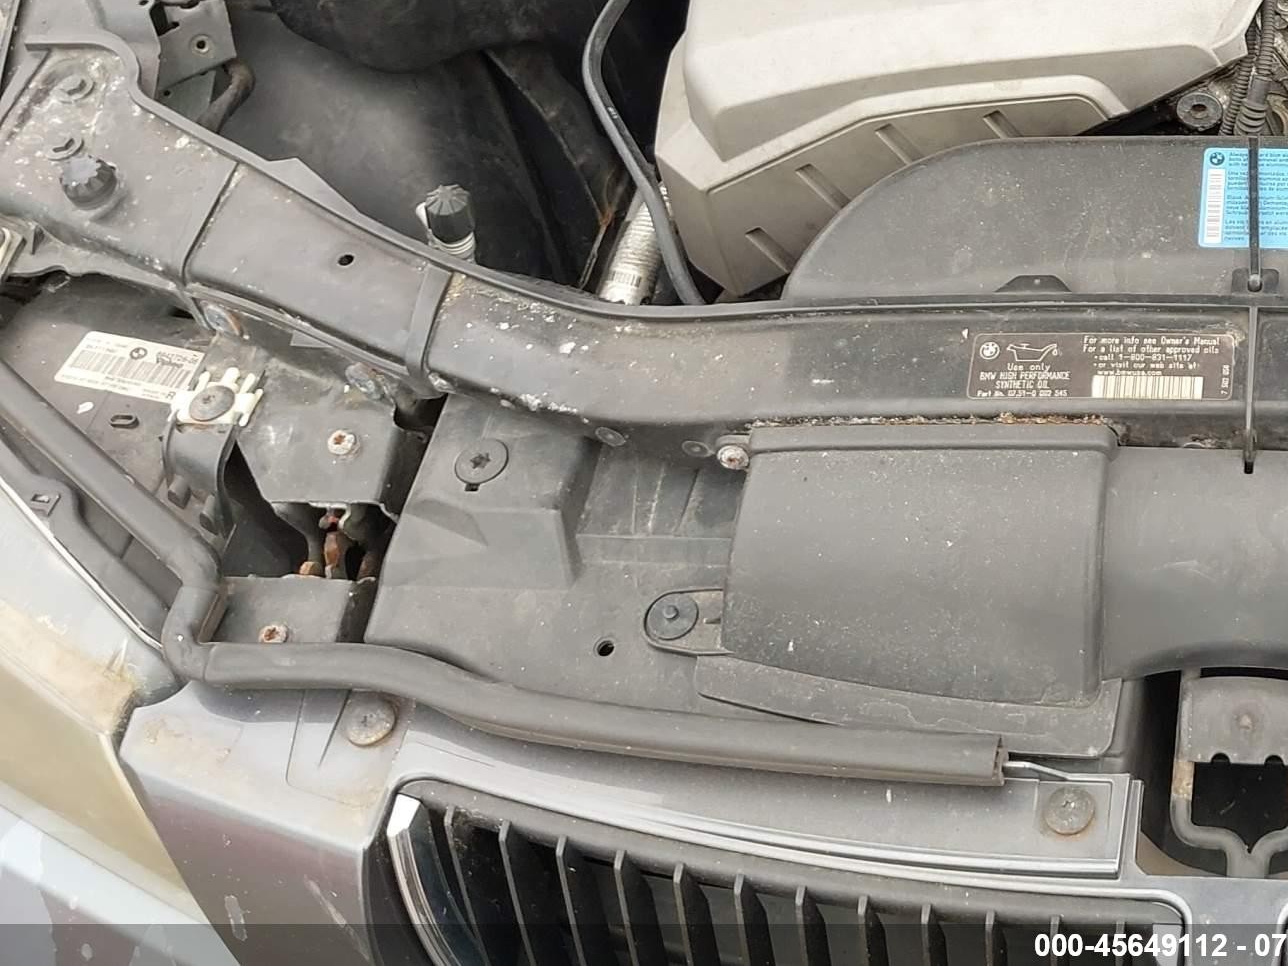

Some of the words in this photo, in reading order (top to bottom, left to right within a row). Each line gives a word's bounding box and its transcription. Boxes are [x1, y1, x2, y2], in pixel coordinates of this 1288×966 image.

[1084, 336, 1097, 344] For
[1160, 336, 1190, 344] Owner's
[1193, 337, 1220, 345] Manual
[1083, 344, 1096, 352] For
[1109, 345, 1124, 353] list
[1127, 345, 1137, 353] of
[1140, 345, 1161, 353] other
[1166, 346, 1200, 354] approved
[1203, 346, 1219, 354] oils
[1007, 362, 1024, 370] Use
[1030, 362, 1050, 372] only
[980, 371, 996, 380] BMW
[1000, 371, 1017, 380] HIGH
[1020, 371, 1071, 380] PERFORMANCE
[995, 380, 1034, 389] SYNTHETIC
[1038, 380, 1050, 389] OIL
